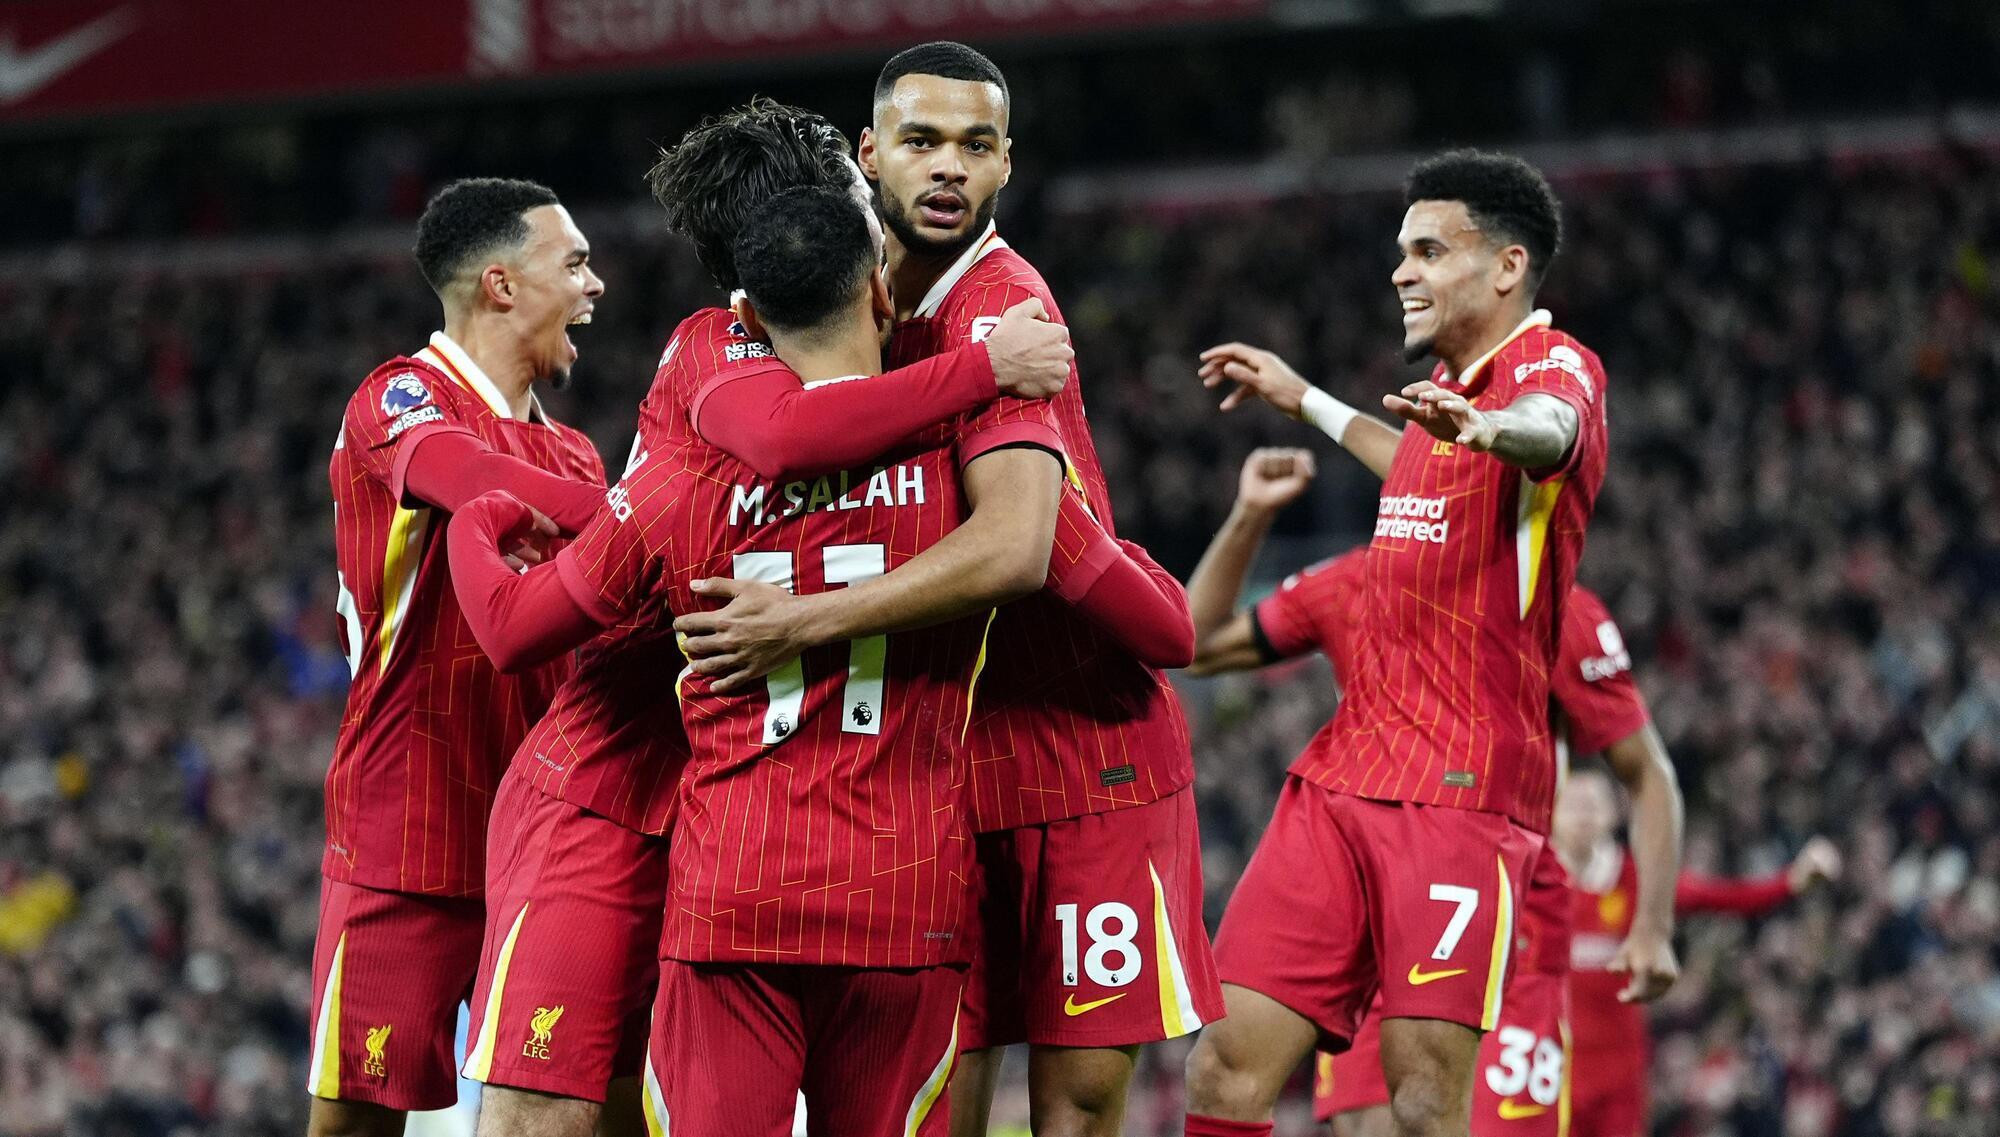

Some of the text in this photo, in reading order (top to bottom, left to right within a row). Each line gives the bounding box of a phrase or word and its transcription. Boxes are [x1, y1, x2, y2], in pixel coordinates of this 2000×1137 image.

[725, 343, 746, 354] No
[1374, 515, 1450, 544] artered
[1379, 493, 1447, 520] andard
[1055, 901, 1143, 988] 18
[1429, 883, 1479, 961] 7
[1485, 1025, 1562, 1106] 38
